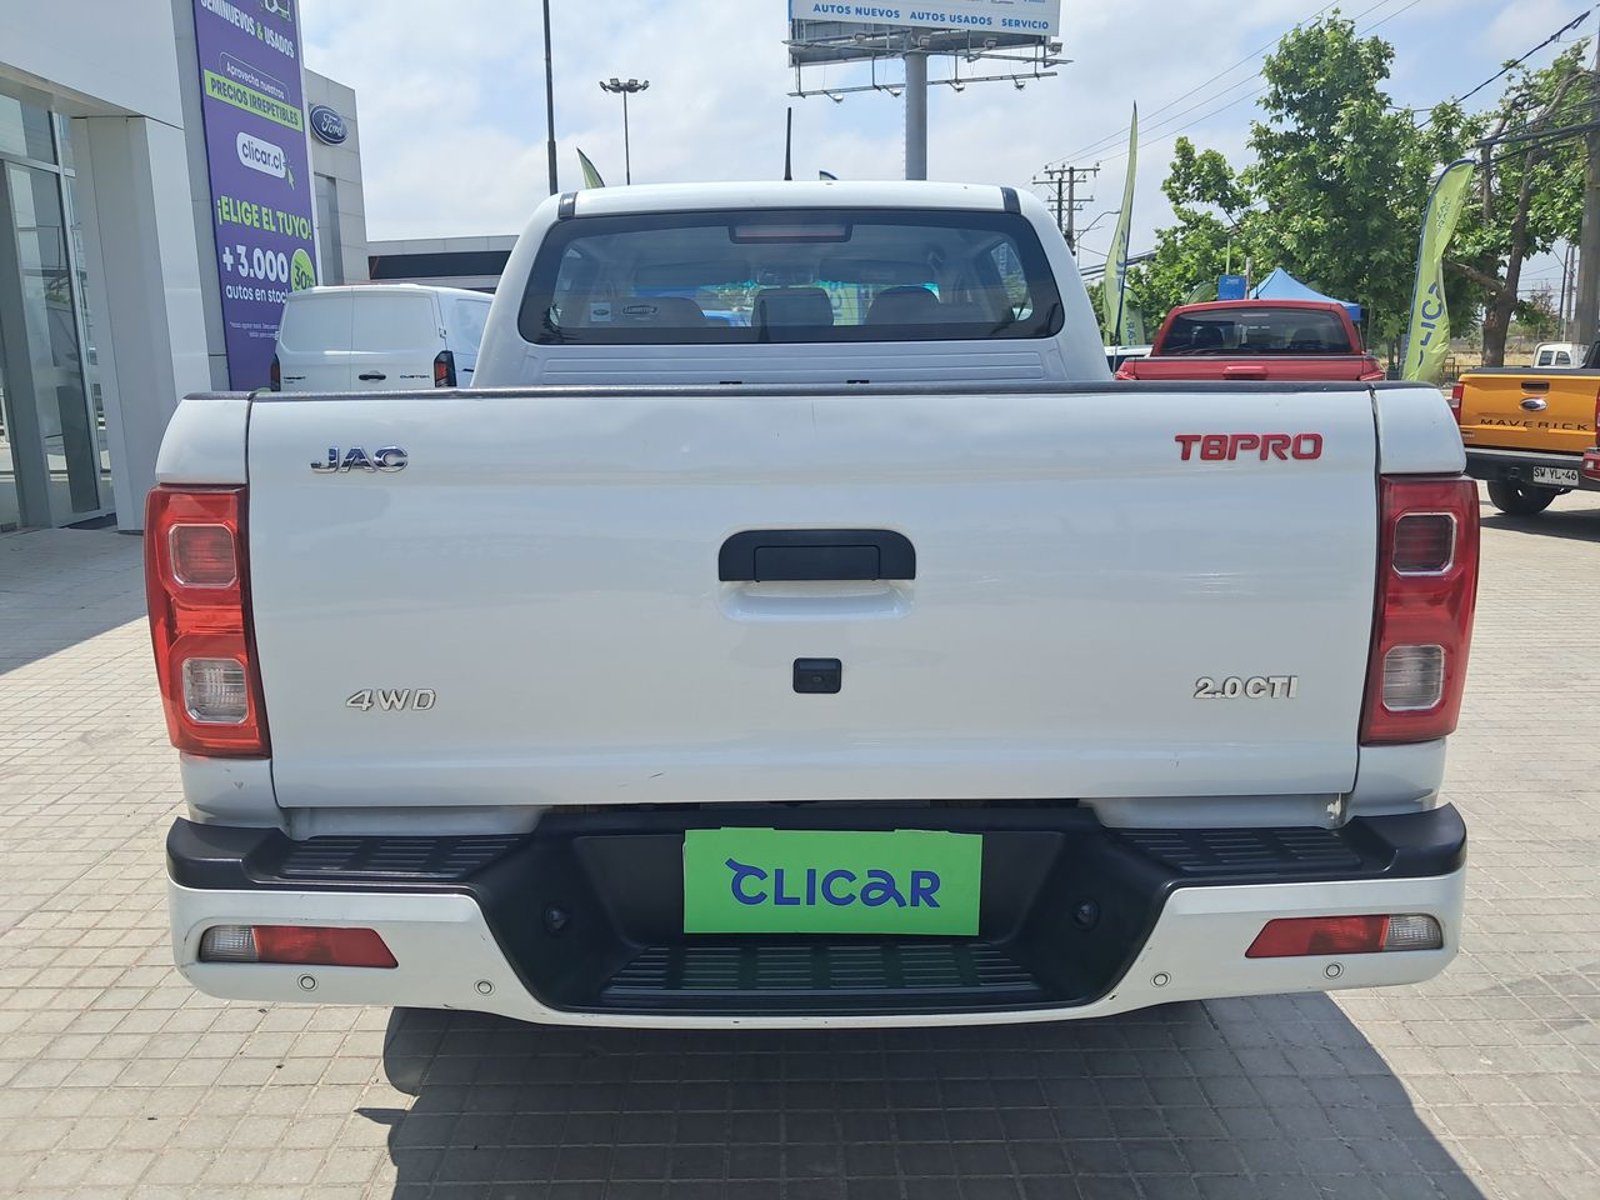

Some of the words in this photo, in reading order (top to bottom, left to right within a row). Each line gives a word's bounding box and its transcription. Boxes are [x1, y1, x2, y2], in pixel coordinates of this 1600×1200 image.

[813, 3, 851, 15] AUTOS
[855, 8, 901, 19] NUEVOS
[909, 11, 946, 22] AUTOS
[949, 14, 993, 26] USADOS
[1001, 18, 1049, 30] SERVICIO
[264, 26, 295, 58] USADOS
[210, 77, 249, 106] PRECIOS
[249, 93, 299, 126] IRREPETIBLES
[321, 113, 342, 137] Ford
[241, 141, 283, 170] clicar.cl
[217, 195, 260, 230] ¡ELIGE
[261, 207, 276, 233] EL
[276, 210, 313, 240] TUYO!
[226, 284, 254, 301] autos
[254, 288, 267, 302] en
[1480, 418, 1589, 431] MAVERICK
[310, 445, 408, 474] JAC
[346, 688, 436, 711] 4WD
[1193, 676, 1298, 699] 2.0CTI
[724, 857, 941, 908] CLICAR
